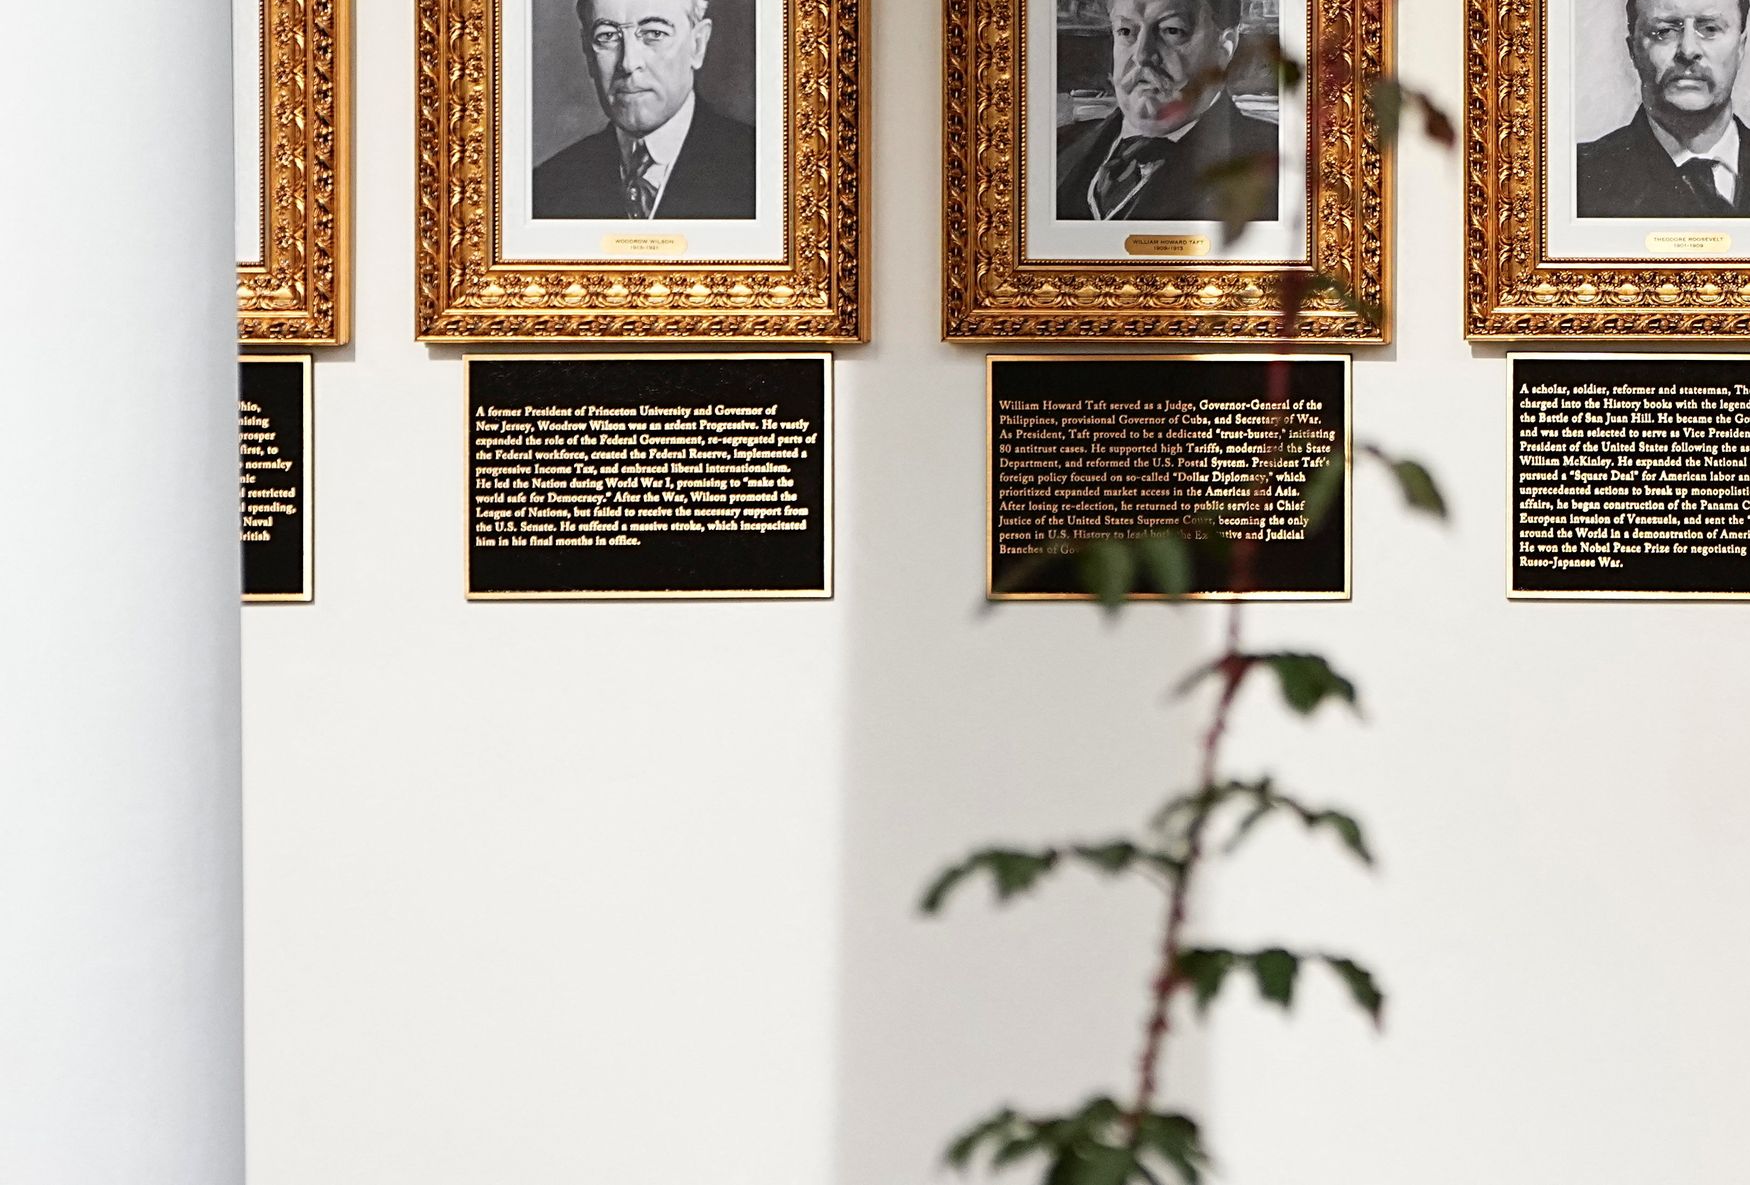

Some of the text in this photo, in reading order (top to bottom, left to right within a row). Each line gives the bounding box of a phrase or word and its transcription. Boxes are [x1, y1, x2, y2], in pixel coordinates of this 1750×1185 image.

[1520, 383, 1529, 394] A
[1532, 384, 1570, 396] scholar,
[1573, 383, 1610, 395] soldier,
[1612, 384, 1656, 394] reformer
[1658, 384, 1676, 394] and
[1680, 387, 1731, 396] statesman,
[475, 404, 778, 418] A former President of Princeton University and Governor of
[999, 400, 1039, 410] William
[1043, 400, 1082, 410] Howard
[1085, 400, 1106, 410] Taft
[1110, 400, 1140, 410] served
[1164, 400, 1196, 412] Judge,
[1199, 399, 1290, 410] Governor-General
[1293, 399, 1304, 410] of
[1306, 400, 1322, 410] the
[1520, 398, 1558, 411] charged
[1561, 399, 1581, 409] into
[1584, 398, 1600, 408] the
[1603, 398, 1641, 411] History
[1643, 399, 1672, 409] books
[1675, 399, 1698, 409] with
[1701, 399, 1717, 409] the
[476, 421, 499, 431] New
[500, 420, 535, 434] Jersey,
[537, 420, 587, 430] Woodrow
[589, 419, 626, 430] Wilson
[664, 419, 697, 430] ardent
[699, 419, 759, 432] Progressive.
[762, 419, 778, 430] He
[780, 418, 810, 432] vastly
[240, 443, 279, 456] first, to
[245, 458, 293, 472] normalcy
[247, 487, 296, 498] restricted
[247, 501, 298, 515] spending,
[1000, 501, 1025, 510] After
[1029, 501, 1058, 513] losing
[1062, 501, 1117, 512] re-election,
[1121, 501, 1132, 510] he
[1136, 501, 1177, 510] returned
[1194, 500, 1224, 513] public
[1227, 501, 1260, 511] service
[1264, 503, 1273, 511] as
[1276, 500, 1305, 511] Chief
[243, 516, 273, 527] Naval
